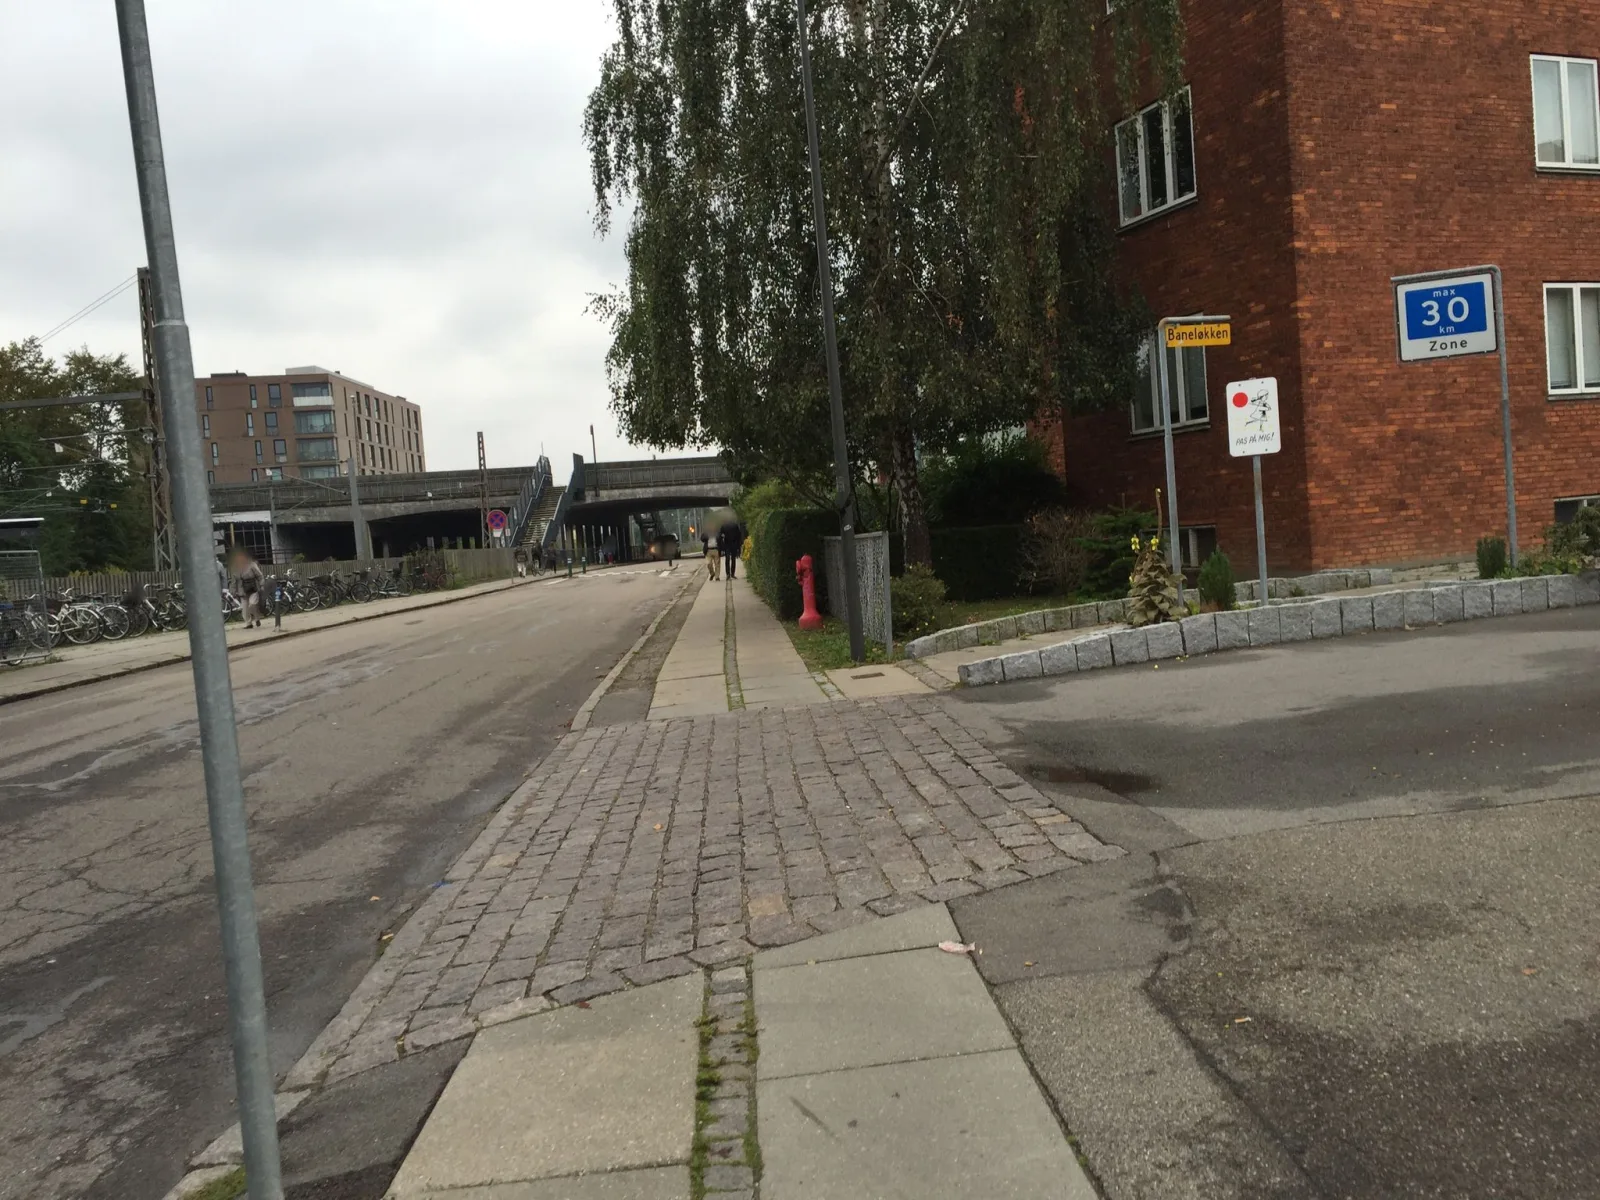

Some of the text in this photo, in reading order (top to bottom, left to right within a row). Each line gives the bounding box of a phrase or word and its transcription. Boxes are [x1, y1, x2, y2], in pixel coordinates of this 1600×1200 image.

[1433, 289, 1455, 297] max
[1421, 296, 1469, 326] 30
[1168, 328, 1229, 341] Baneløkken
[1429, 339, 1468, 352] Zone
[1236, 437, 1248, 446] PAS
